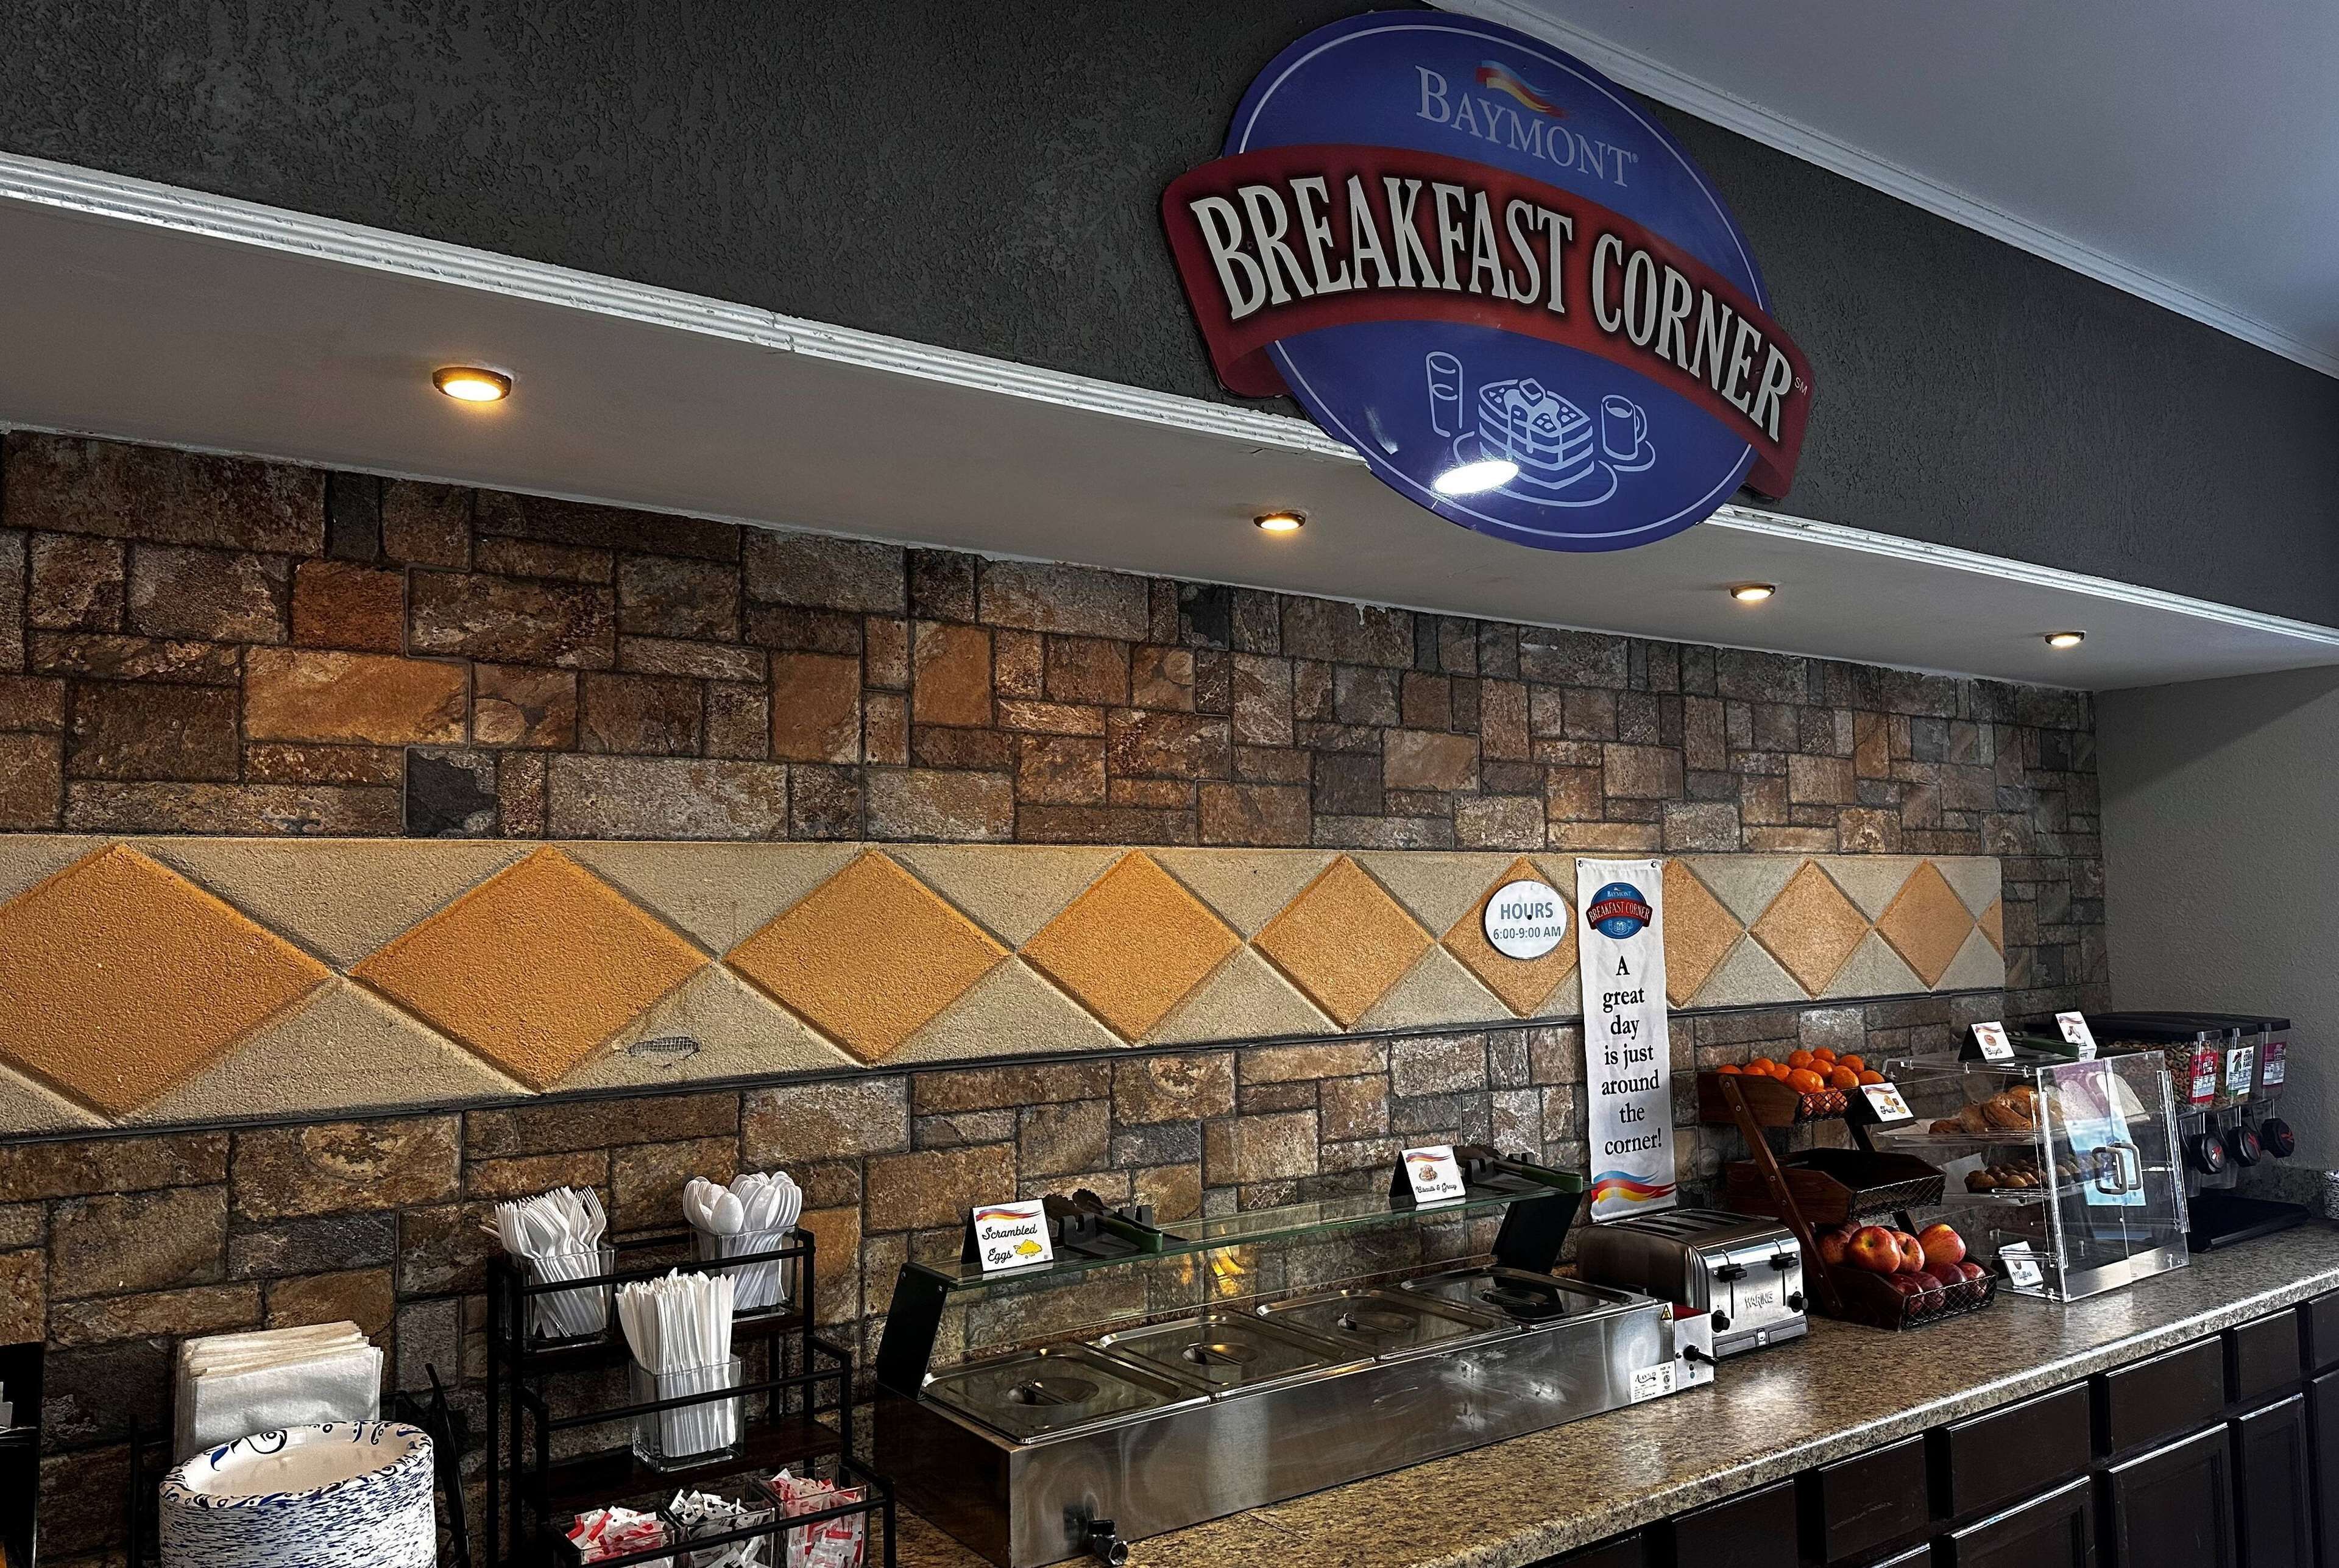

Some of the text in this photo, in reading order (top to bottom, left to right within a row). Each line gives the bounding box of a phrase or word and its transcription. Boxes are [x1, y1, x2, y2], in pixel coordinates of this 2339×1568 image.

[1190, 174, 1574, 320] BREAKFAST
[1591, 233, 1795, 443] CORNER
[1501, 902, 1554, 920] HOURS
[1588, 902, 1650, 923] BREAKFAST CORNER
[1493, 926, 1561, 940] 6:00-9:00 AM
[1615, 955, 1630, 976] A
[1602, 987, 1645, 1014] great
[1610, 1015, 1640, 1039] day
[1604, 1044, 1654, 1071] is just
[1601, 1070, 1660, 1095] around
[1619, 1103, 1645, 1124] the
[1604, 1128, 1662, 1156] corner!
[982, 1223, 1038, 1240] Scrambled
[987, 1247, 1013, 1265] Eggs
